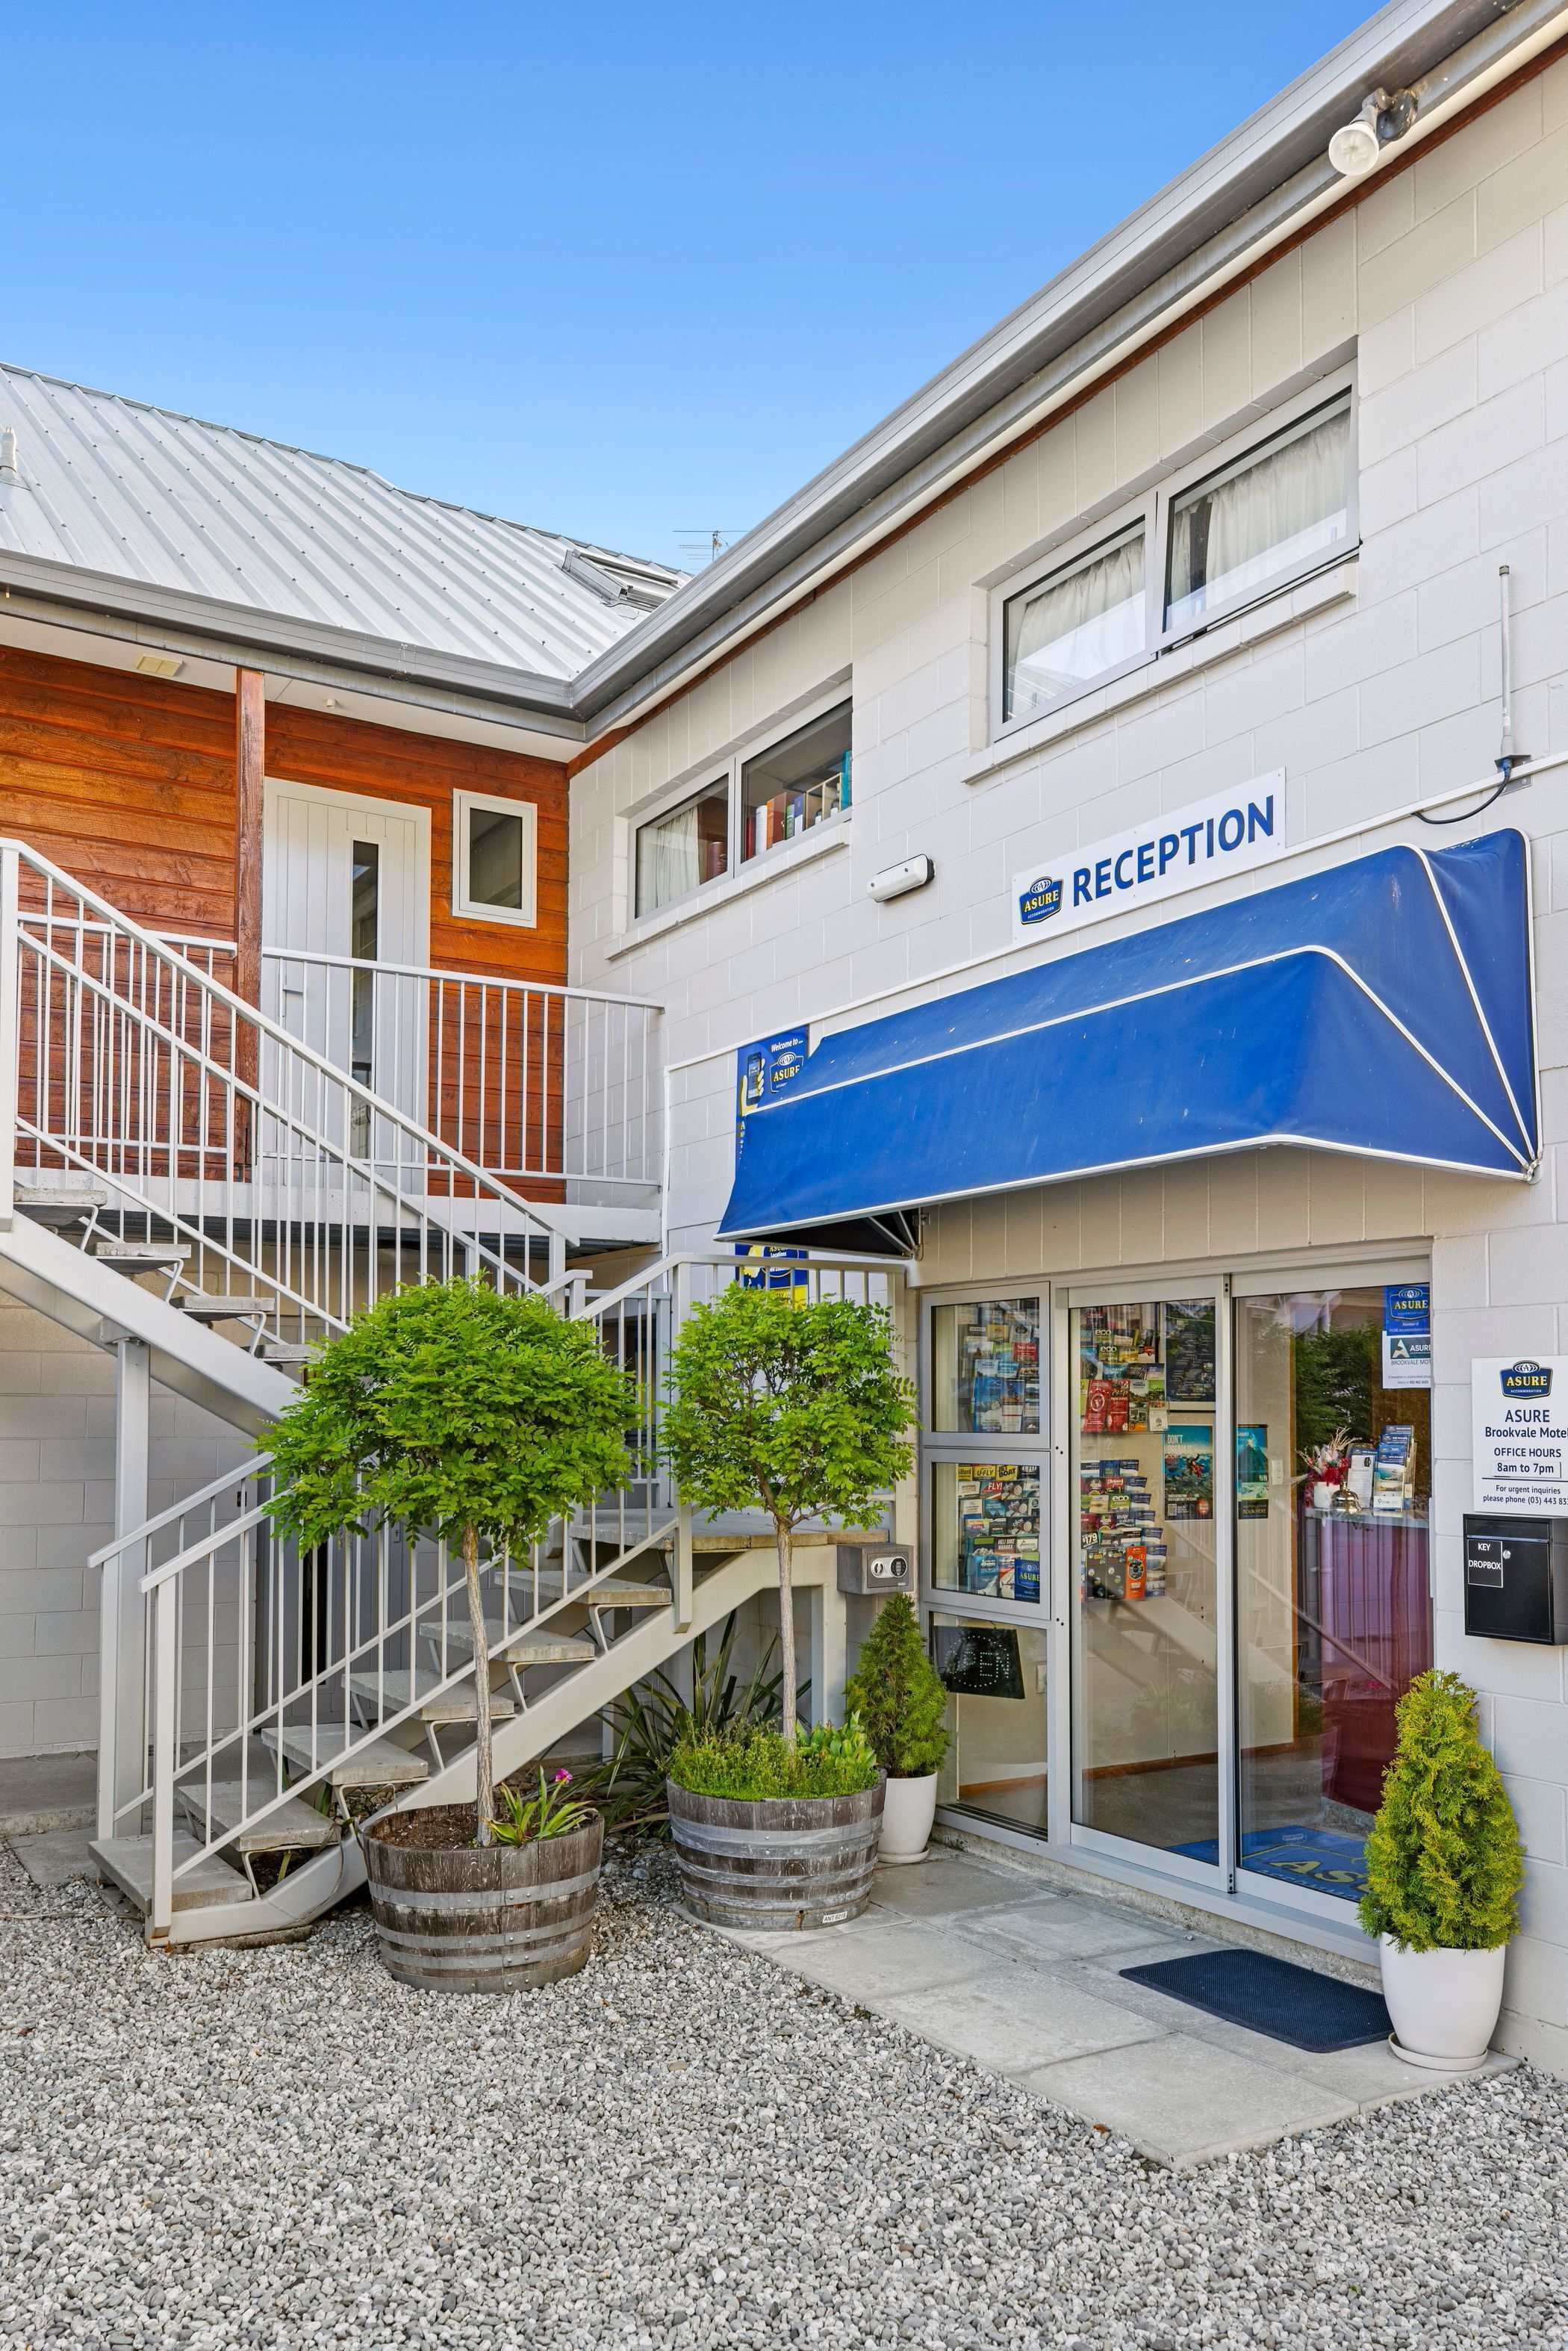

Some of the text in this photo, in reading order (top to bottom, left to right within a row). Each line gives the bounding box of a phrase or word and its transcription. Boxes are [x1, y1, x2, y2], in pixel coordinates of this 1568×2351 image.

[1073, 795, 1274, 907] RECEPTION
[1024, 889, 1059, 912] ASURE
[1028, 906, 1054, 919] ACCOMMODATION
[771, 1040, 792, 1052] Welcome
[1394, 1299, 1428, 1310] ASURE
[1507, 1376, 1547, 1386] ASURE
[1505, 1409, 1550, 1423] ASURE
[1485, 1426, 1537, 1438] Brookvale
[1167, 1435, 1183, 1444] DON'T
[1494, 1447, 1561, 1458] OFFICE HOURS
[998, 1468, 1016, 1478] BOAT
[1497, 1462, 1554, 1475] 8am to 7pm
[1531, 1486, 1561, 1494] inquiries
[1483, 1494, 1504, 1503] please
[1528, 1497, 1542, 1506] (03)
[1082, 1532, 1098, 1544] $179
[1478, 1543, 1491, 1551] KEY
[1469, 1559, 1502, 1570] DROPBOX
[1019, 1572, 1040, 1581] ASURE
